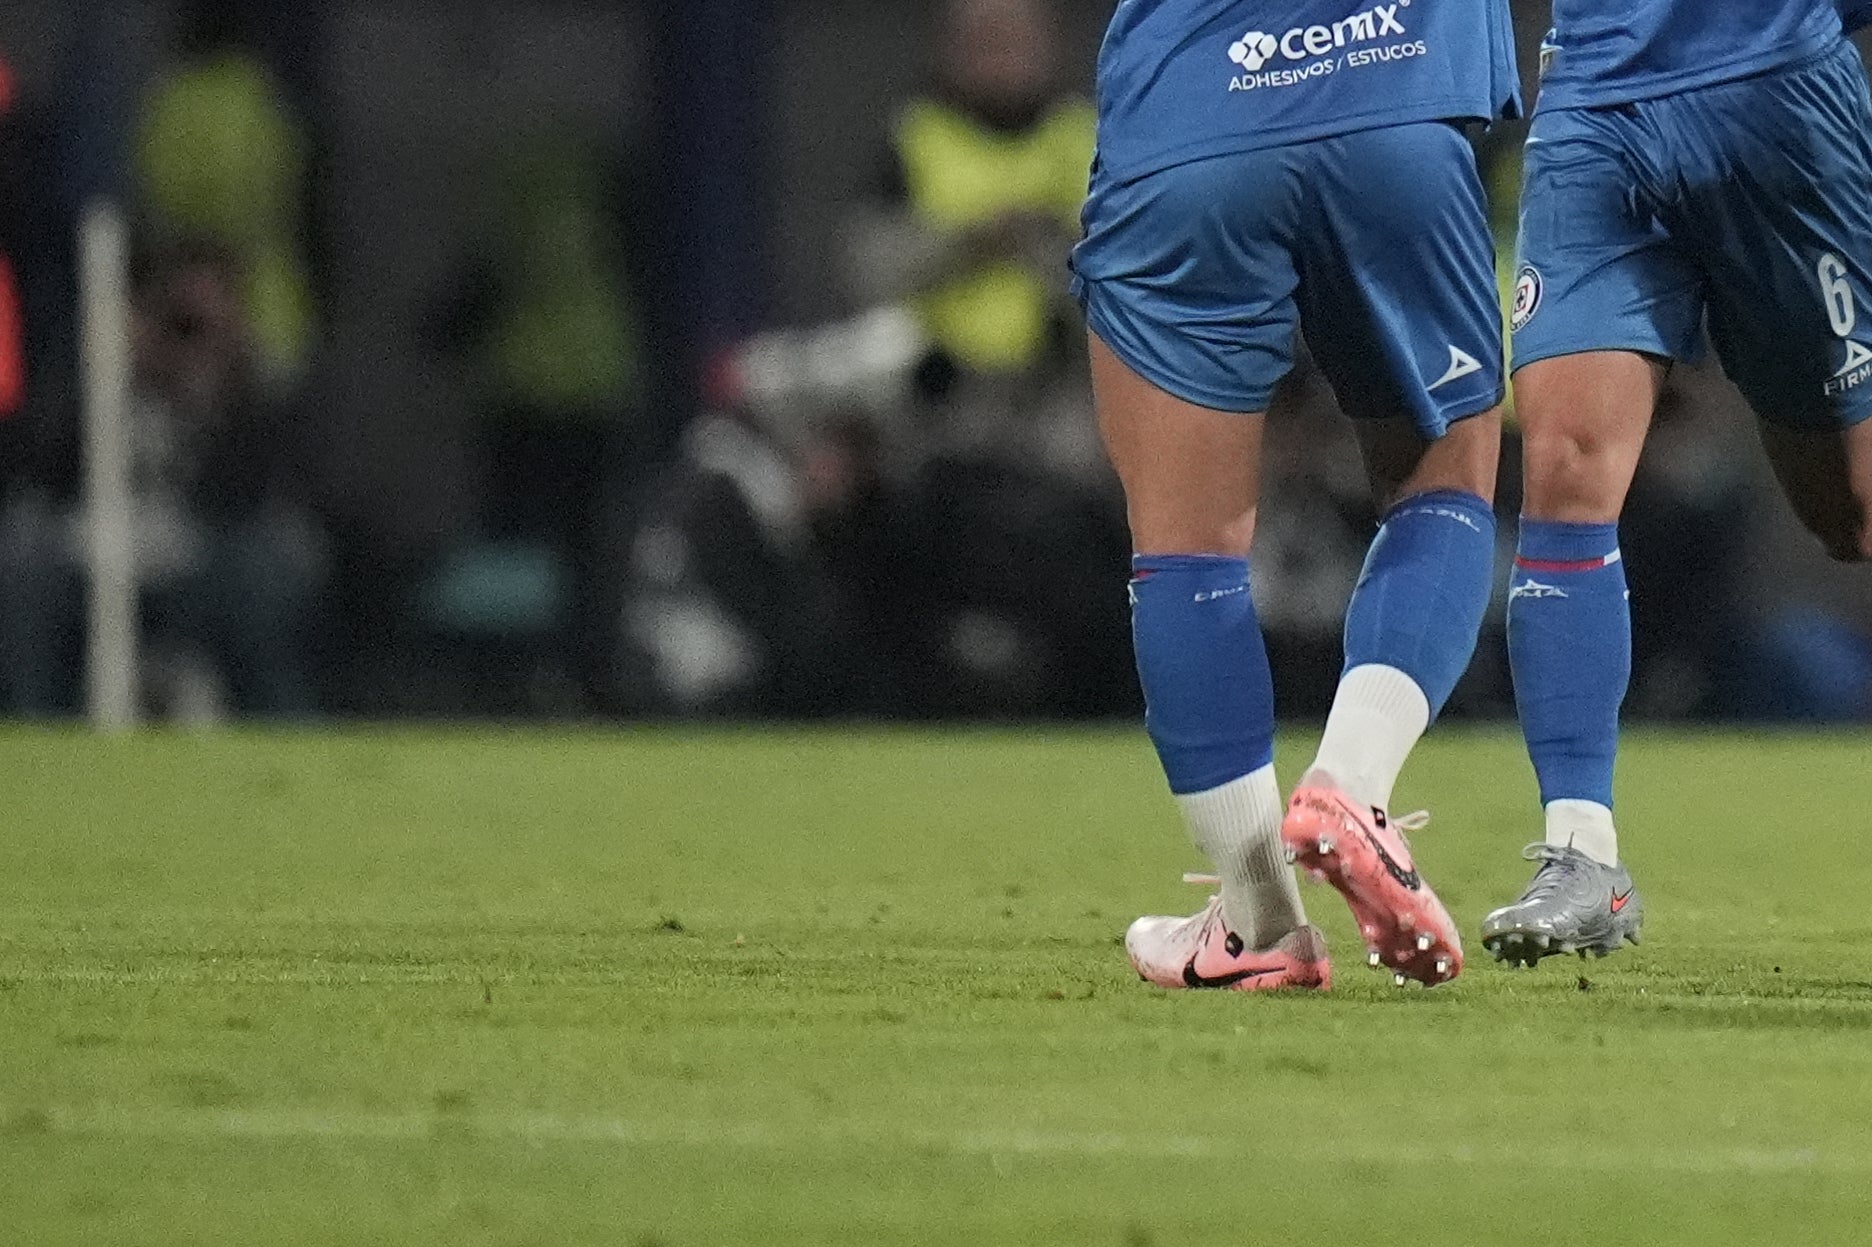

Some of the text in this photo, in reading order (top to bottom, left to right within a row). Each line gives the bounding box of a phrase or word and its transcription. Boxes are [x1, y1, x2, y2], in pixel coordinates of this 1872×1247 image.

[1228, 58, 1334, 91] ADHESIVOS
[1347, 40, 1427, 68] ESTUCOS
[1817, 252, 1855, 337] 6
